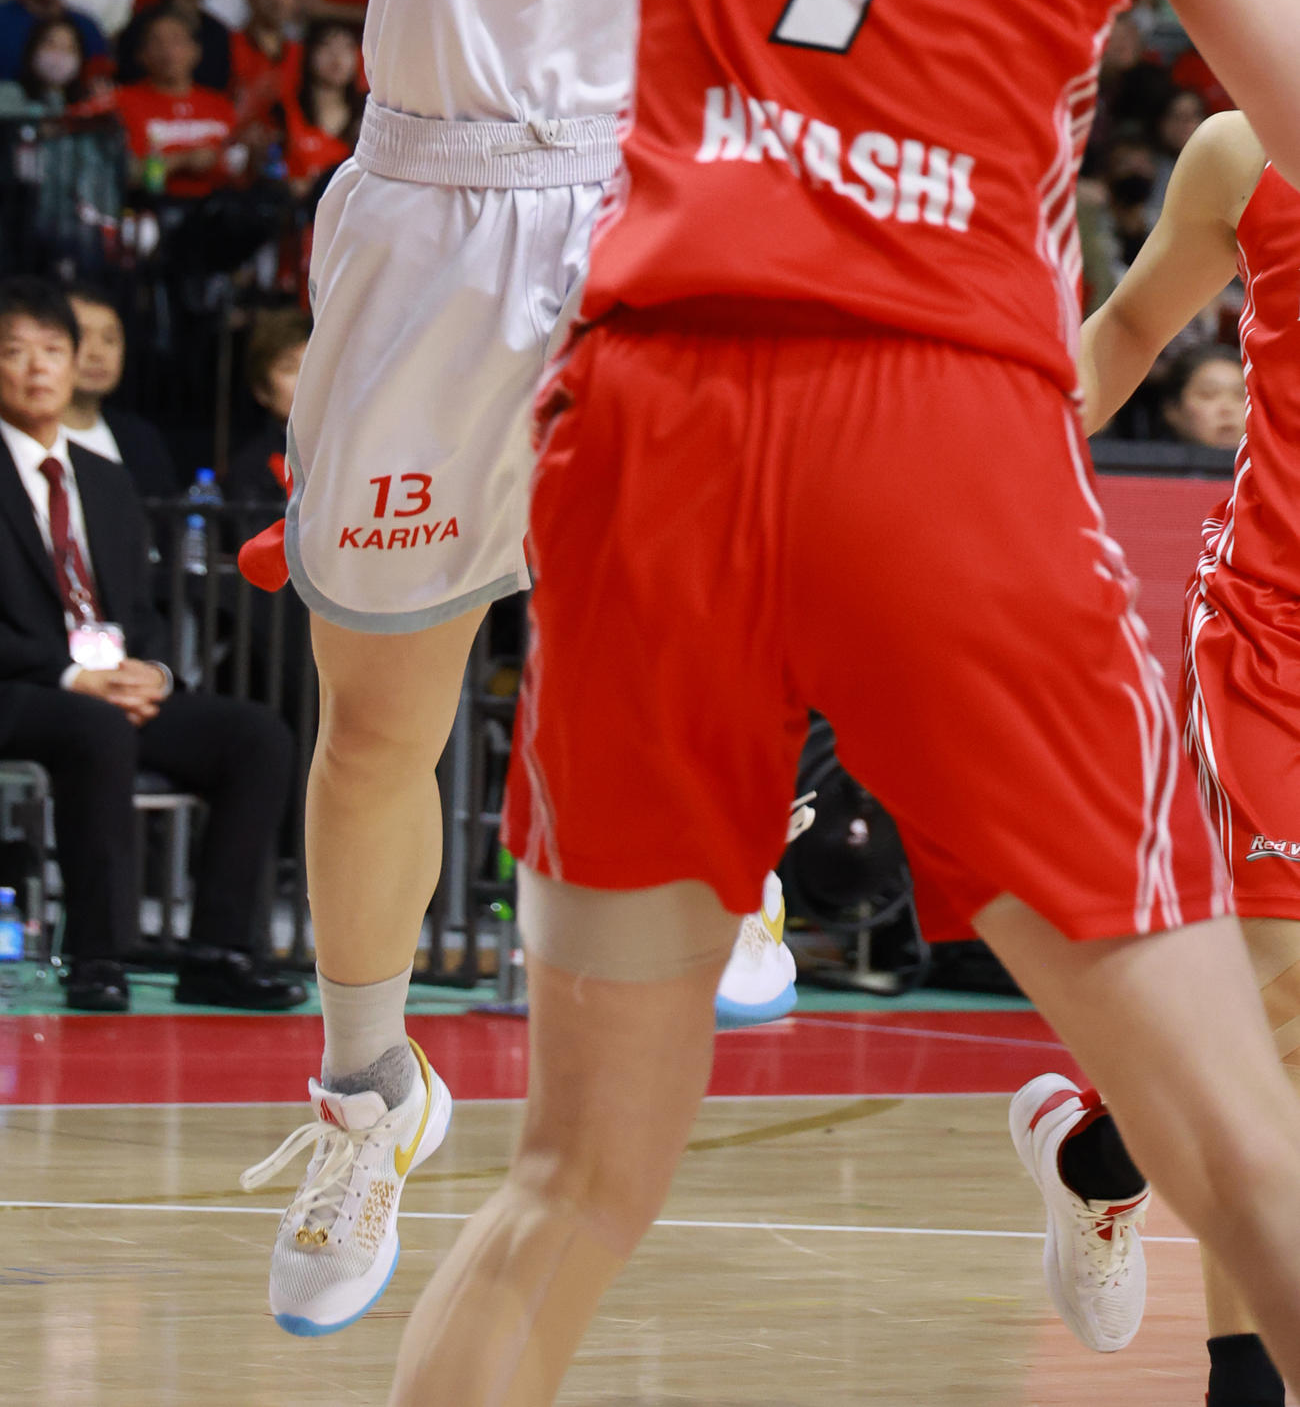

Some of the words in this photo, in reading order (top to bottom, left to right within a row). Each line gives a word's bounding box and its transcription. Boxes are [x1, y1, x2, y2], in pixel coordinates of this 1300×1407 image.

[369, 473, 433, 519] 13
[338, 516, 459, 550] KARIYA
[1250, 834, 1288, 852] Red
